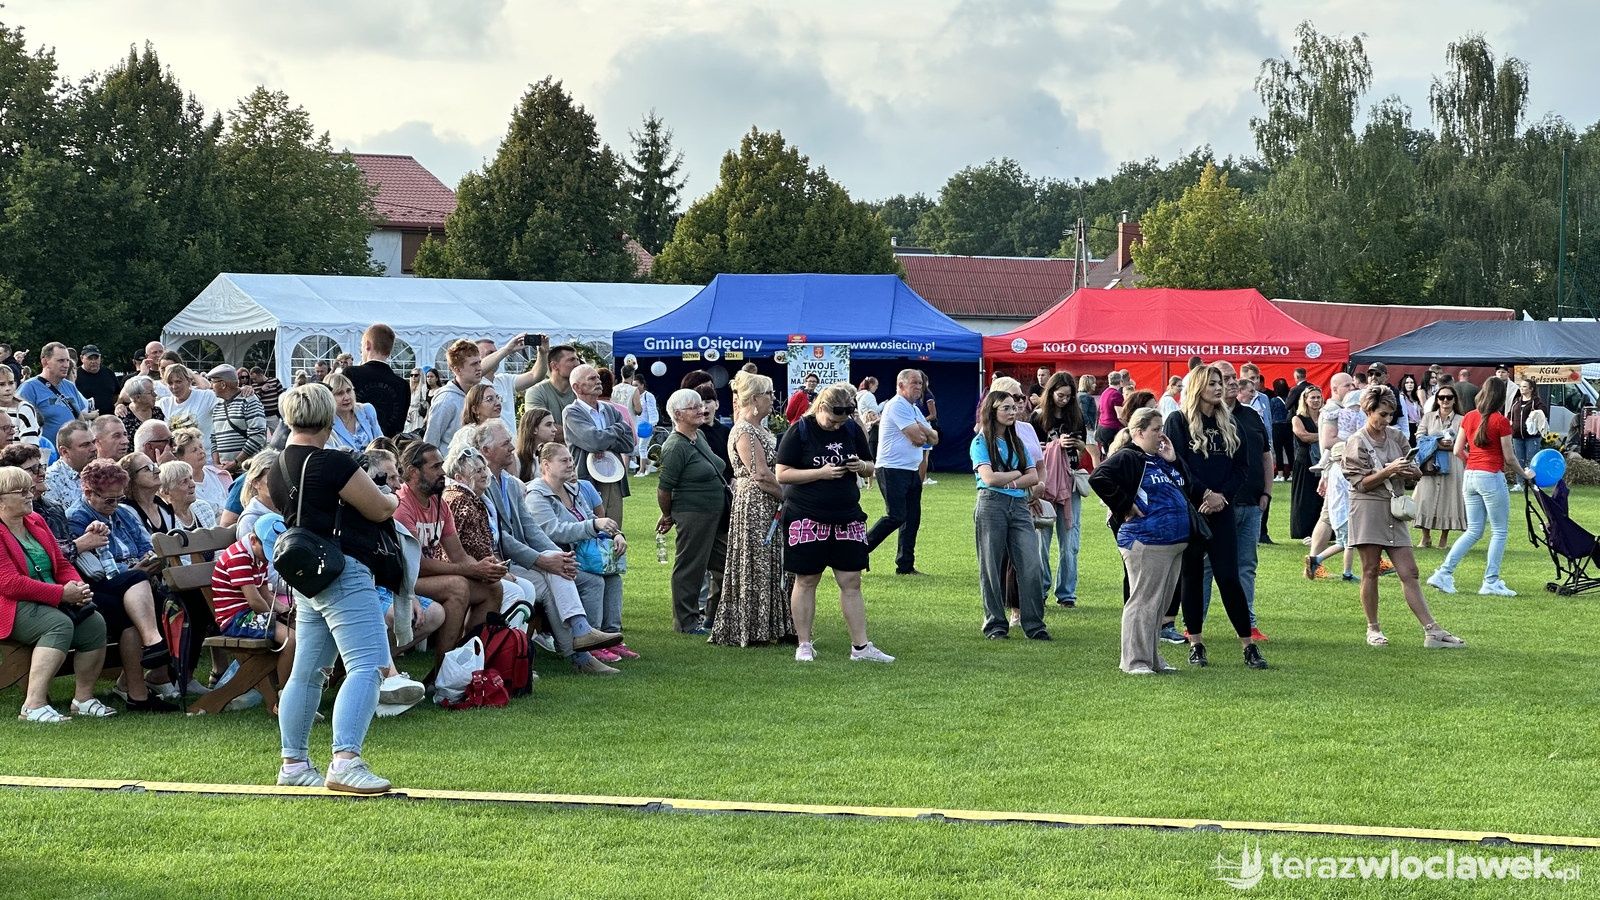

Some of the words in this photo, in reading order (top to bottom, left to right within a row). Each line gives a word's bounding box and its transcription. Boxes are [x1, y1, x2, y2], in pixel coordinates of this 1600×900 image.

[644, 336, 693, 350] Gmina
[698, 336, 763, 352] Osięciny
[850, 339, 935, 352] www.osieciny.pl
[1042, 343, 1077, 353] KOŁO
[1080, 343, 1148, 354] GOSPODYŃ
[1151, 344, 1219, 356] WIEJSKICH
[1222, 345, 1290, 355] BEŁSZEWO
[803, 362, 835, 370] TWOJE
